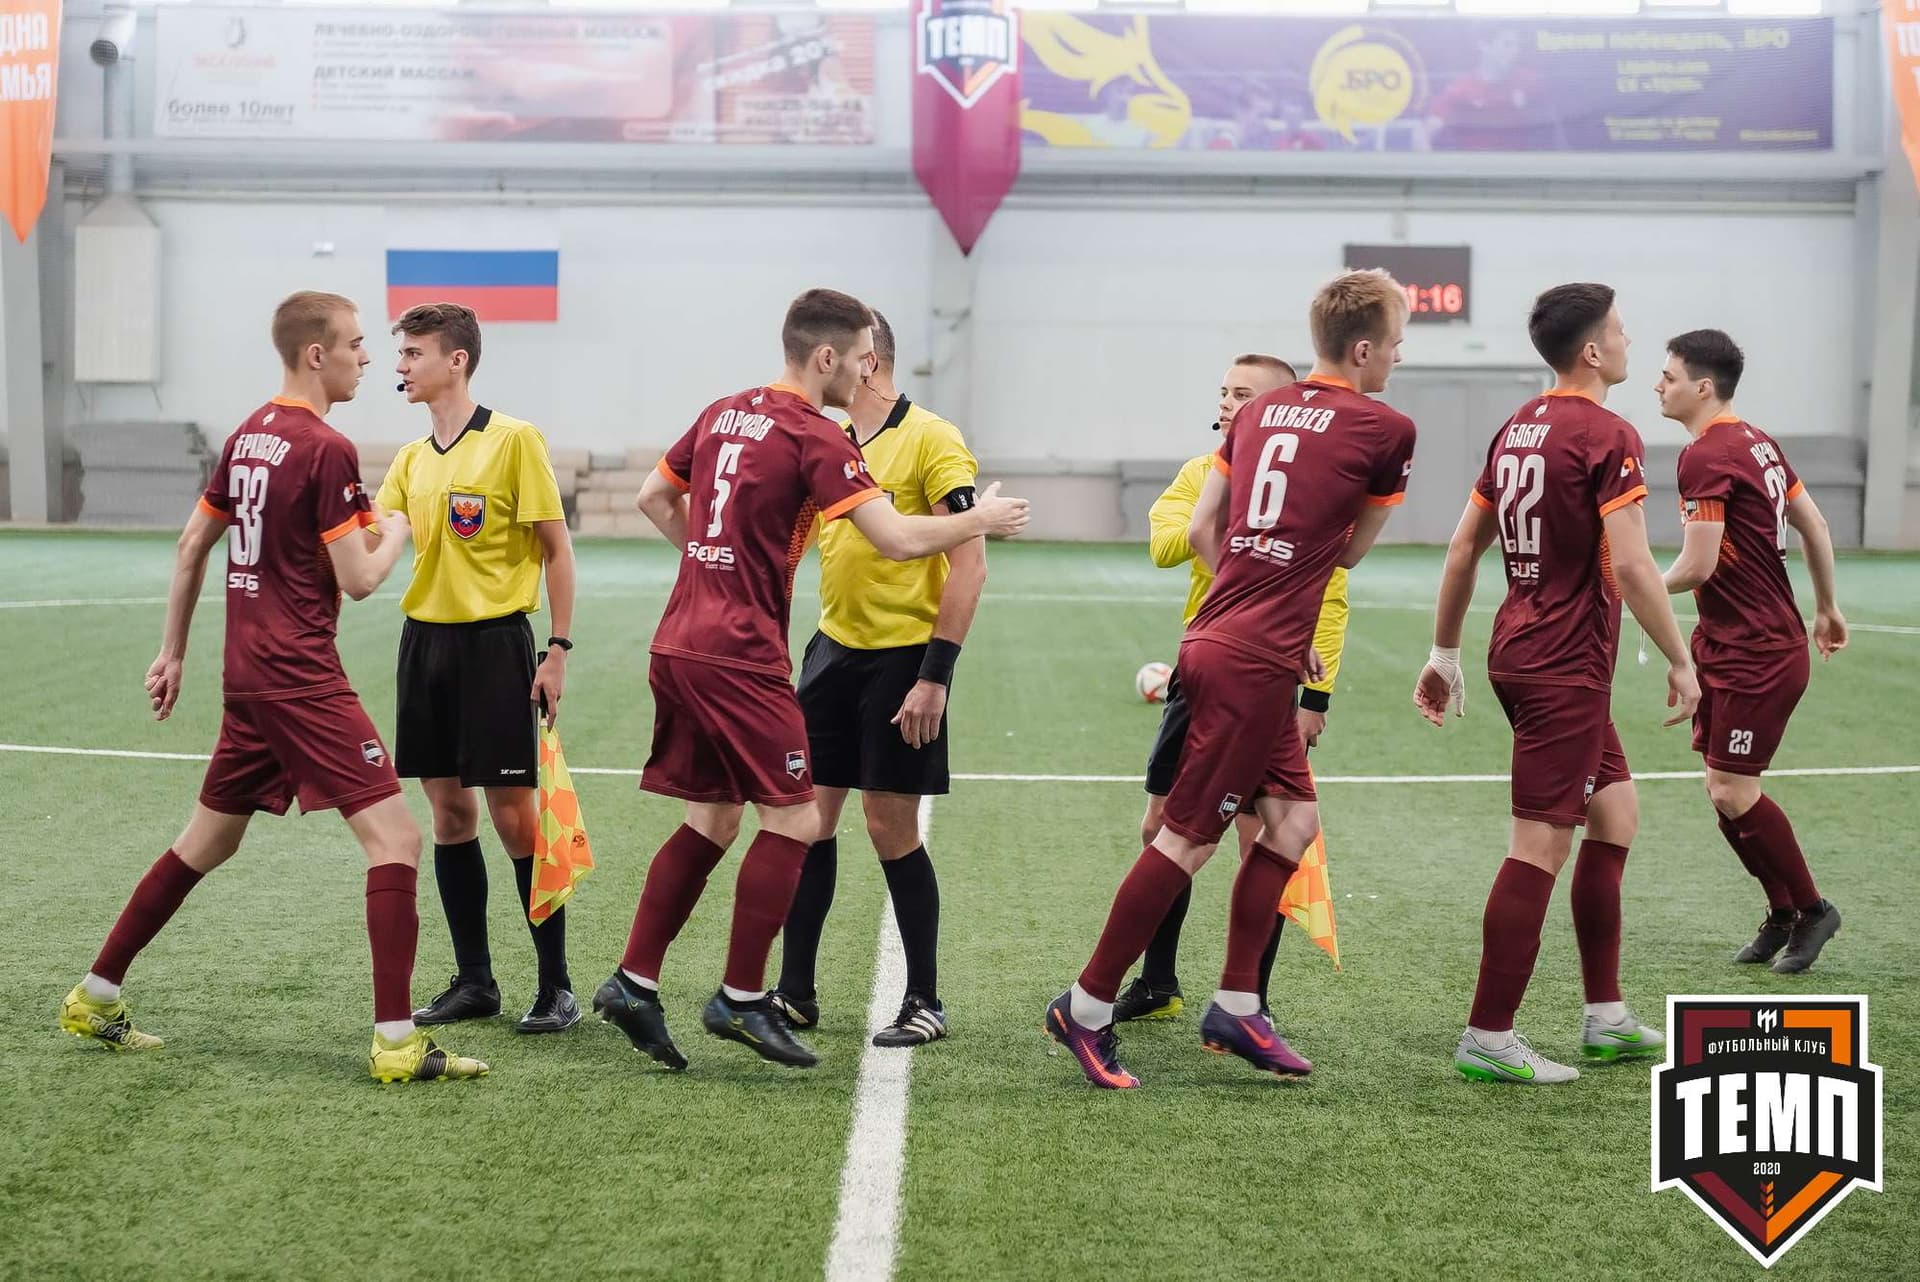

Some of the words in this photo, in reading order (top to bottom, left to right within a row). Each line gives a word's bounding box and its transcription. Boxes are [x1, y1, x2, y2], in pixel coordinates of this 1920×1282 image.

[926, 15, 1007, 60] ТЕМП
[1259, 403, 1336, 433] КНЯЗЕВ
[1505, 423, 1551, 449] БАБИЧ
[228, 464, 270, 567] 33
[706, 441, 745, 538] 5
[1246, 433, 1300, 530] 6
[1496, 453, 1546, 555] 22
[1728, 729, 1753, 755] 23
